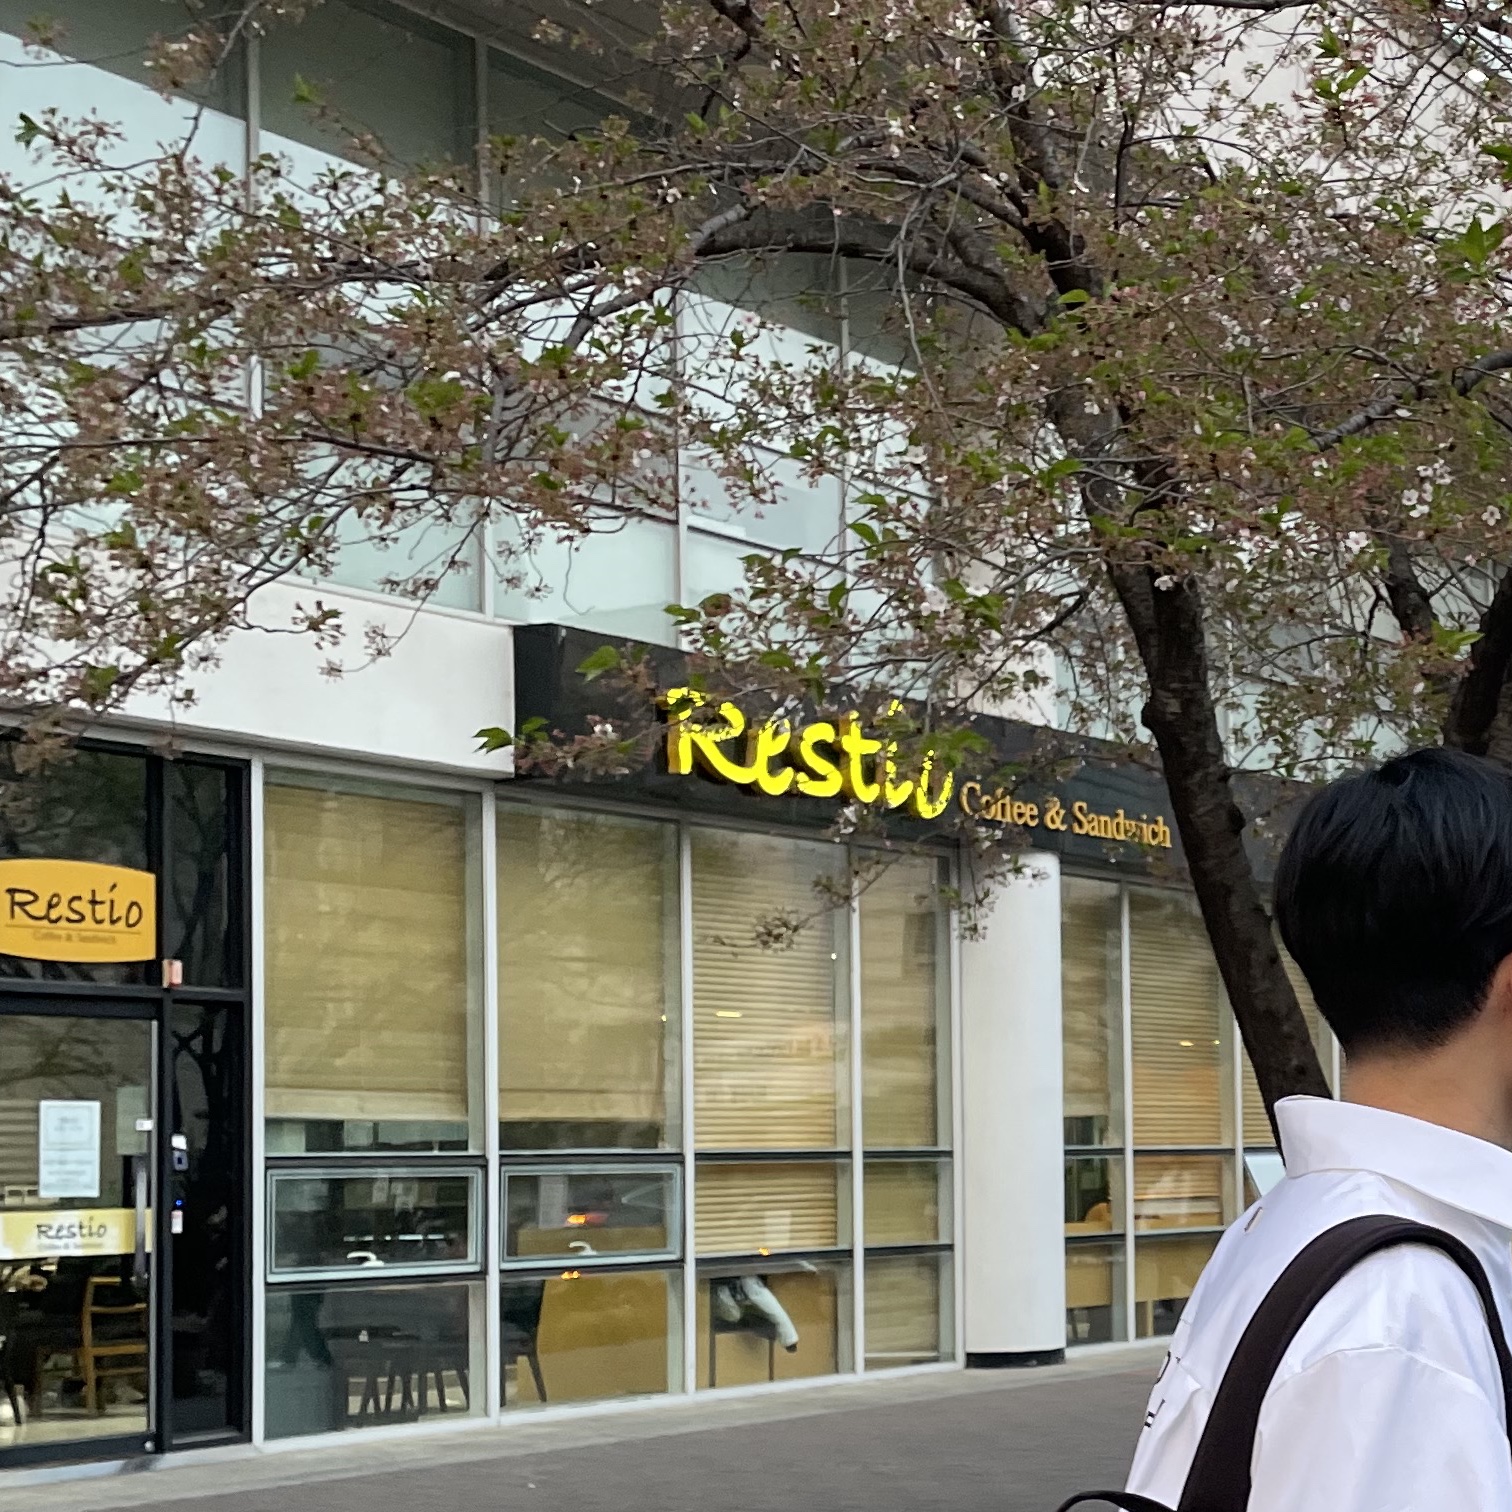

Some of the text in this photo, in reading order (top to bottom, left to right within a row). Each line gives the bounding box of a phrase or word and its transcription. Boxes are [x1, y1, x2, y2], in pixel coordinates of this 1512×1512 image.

[1044, 796, 1067, 831] &
[1072, 801, 1172, 848] Sandwich
[5, 882, 143, 928] Restio
[36, 1216, 108, 1240] Restio
